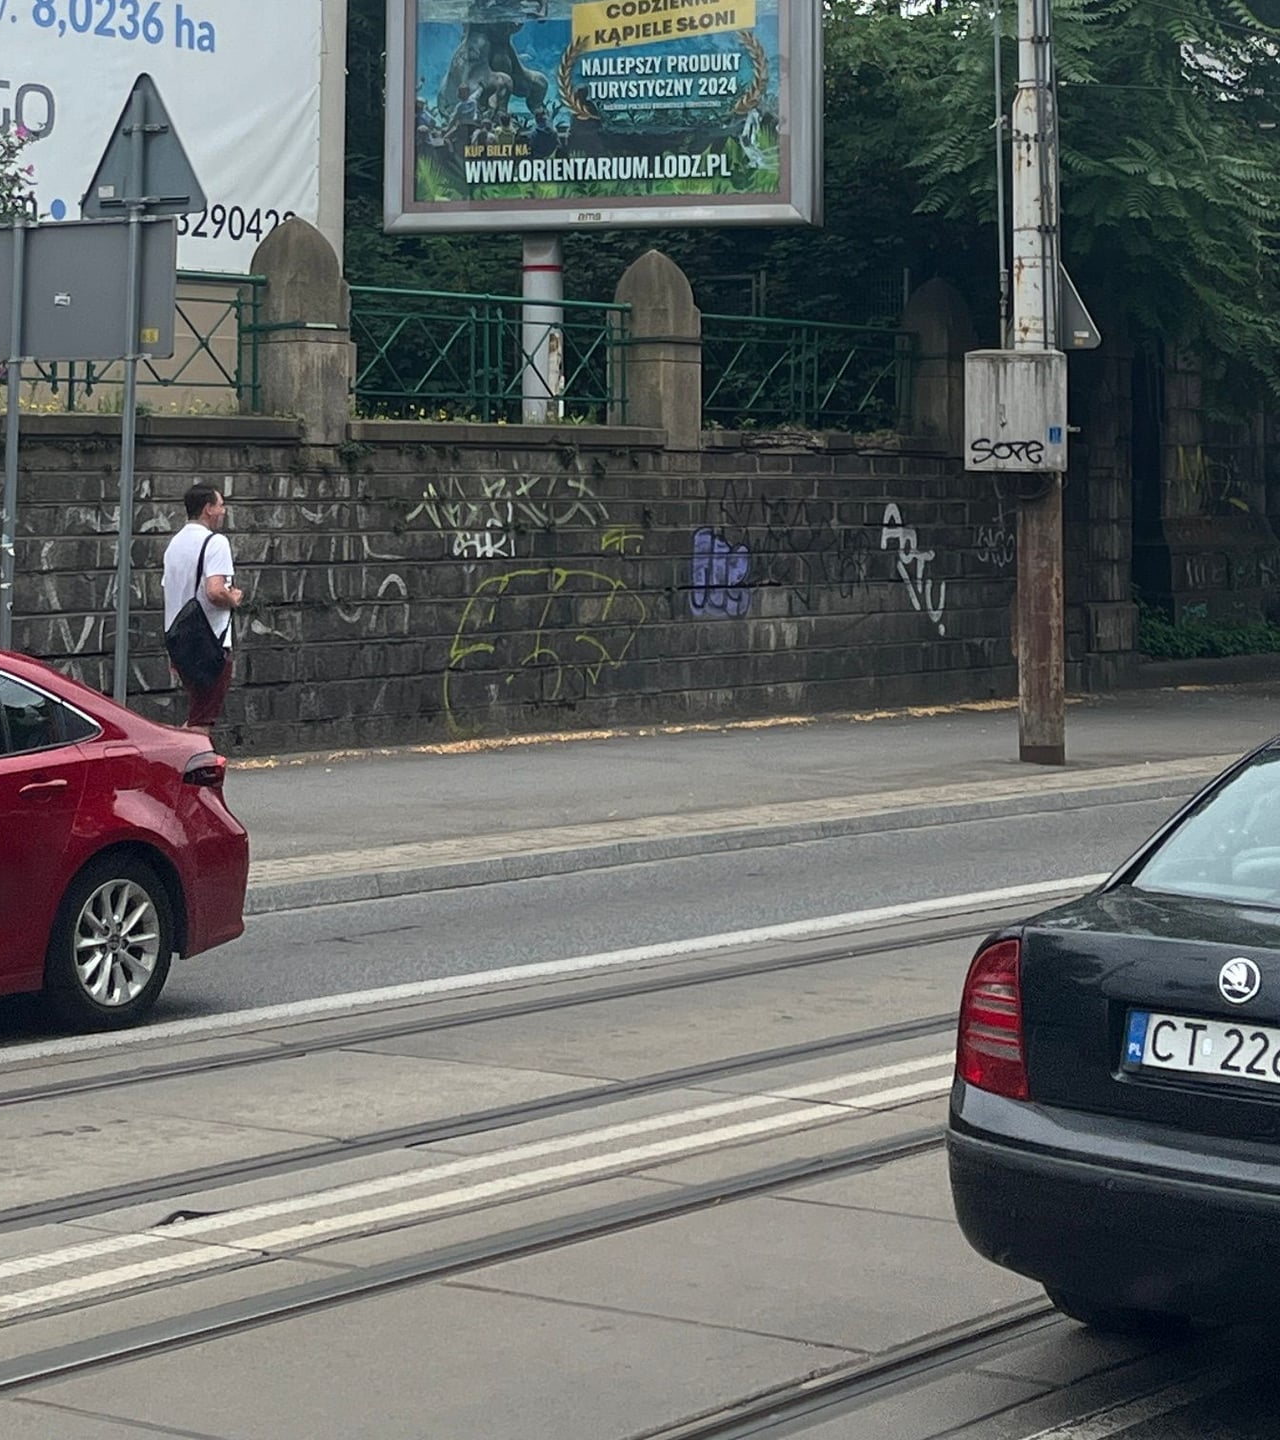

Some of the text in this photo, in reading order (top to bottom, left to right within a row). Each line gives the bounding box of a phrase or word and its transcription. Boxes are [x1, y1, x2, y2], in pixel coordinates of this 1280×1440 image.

[175, 3, 217, 54] ha
[594, 10, 736, 47] KĄPIELE SŁONI
[581, 53, 741, 77] NAJLEPSZY PRODUKT
[588, 76, 738, 99] TURYSTYCZNY 2024
[464, 145, 485, 157] KUP
[465, 154, 731, 184] WWW.ORIENTARIUM.LODZ.PL
[1128, 1042, 1142, 1057] PL
[1151, 1019, 1208, 1066] CT
